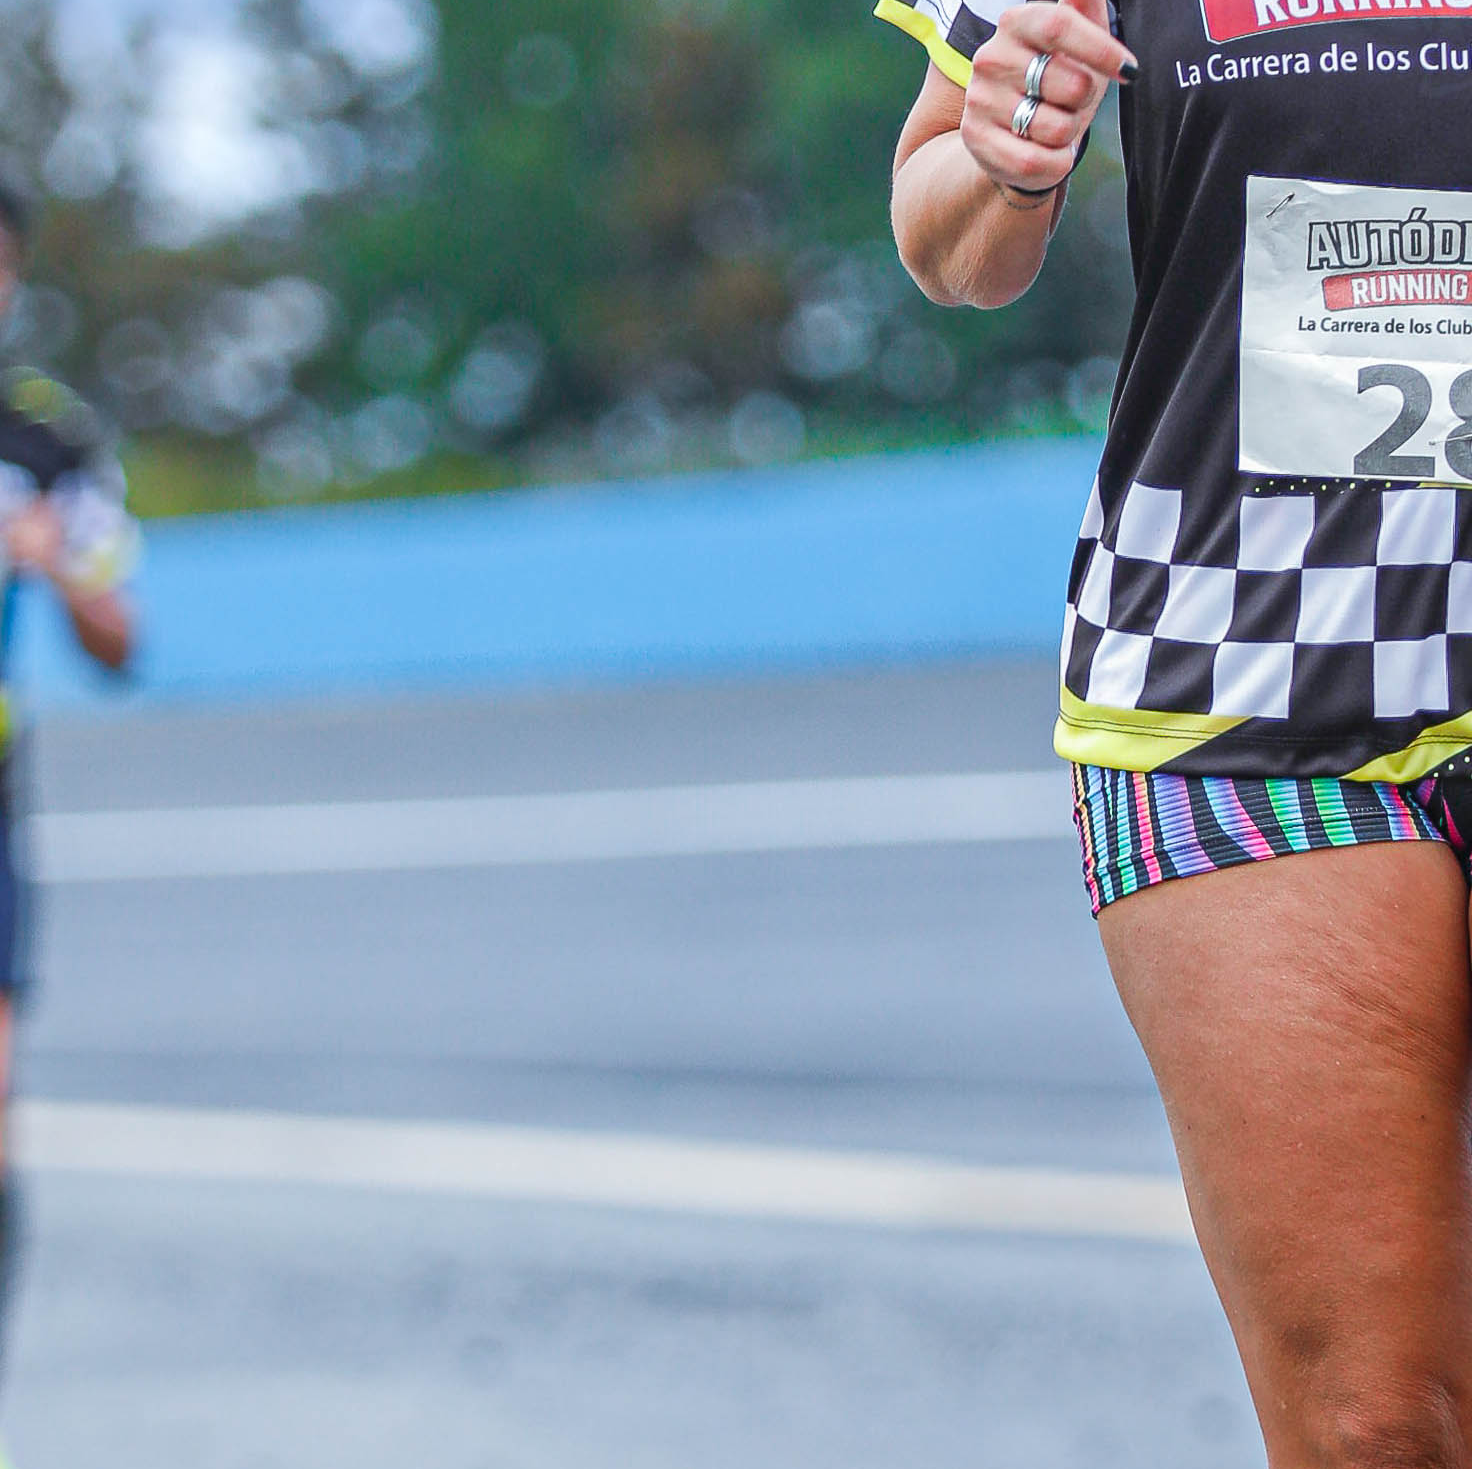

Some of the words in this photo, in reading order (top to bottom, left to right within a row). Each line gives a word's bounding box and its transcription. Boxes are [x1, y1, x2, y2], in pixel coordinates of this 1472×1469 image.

[1175, 60, 1202, 88] La
[1206, 53, 1311, 82] Carrera
[1319, 42, 1358, 73] de
[1366, 42, 1411, 72] los
[1351, 270, 1469, 307] RUNNING
[1297, 315, 1317, 332] La
[1320, 316, 1380, 333] Carrera
[1384, 317, 1405, 334] de
[1409, 317, 1432, 334] los
